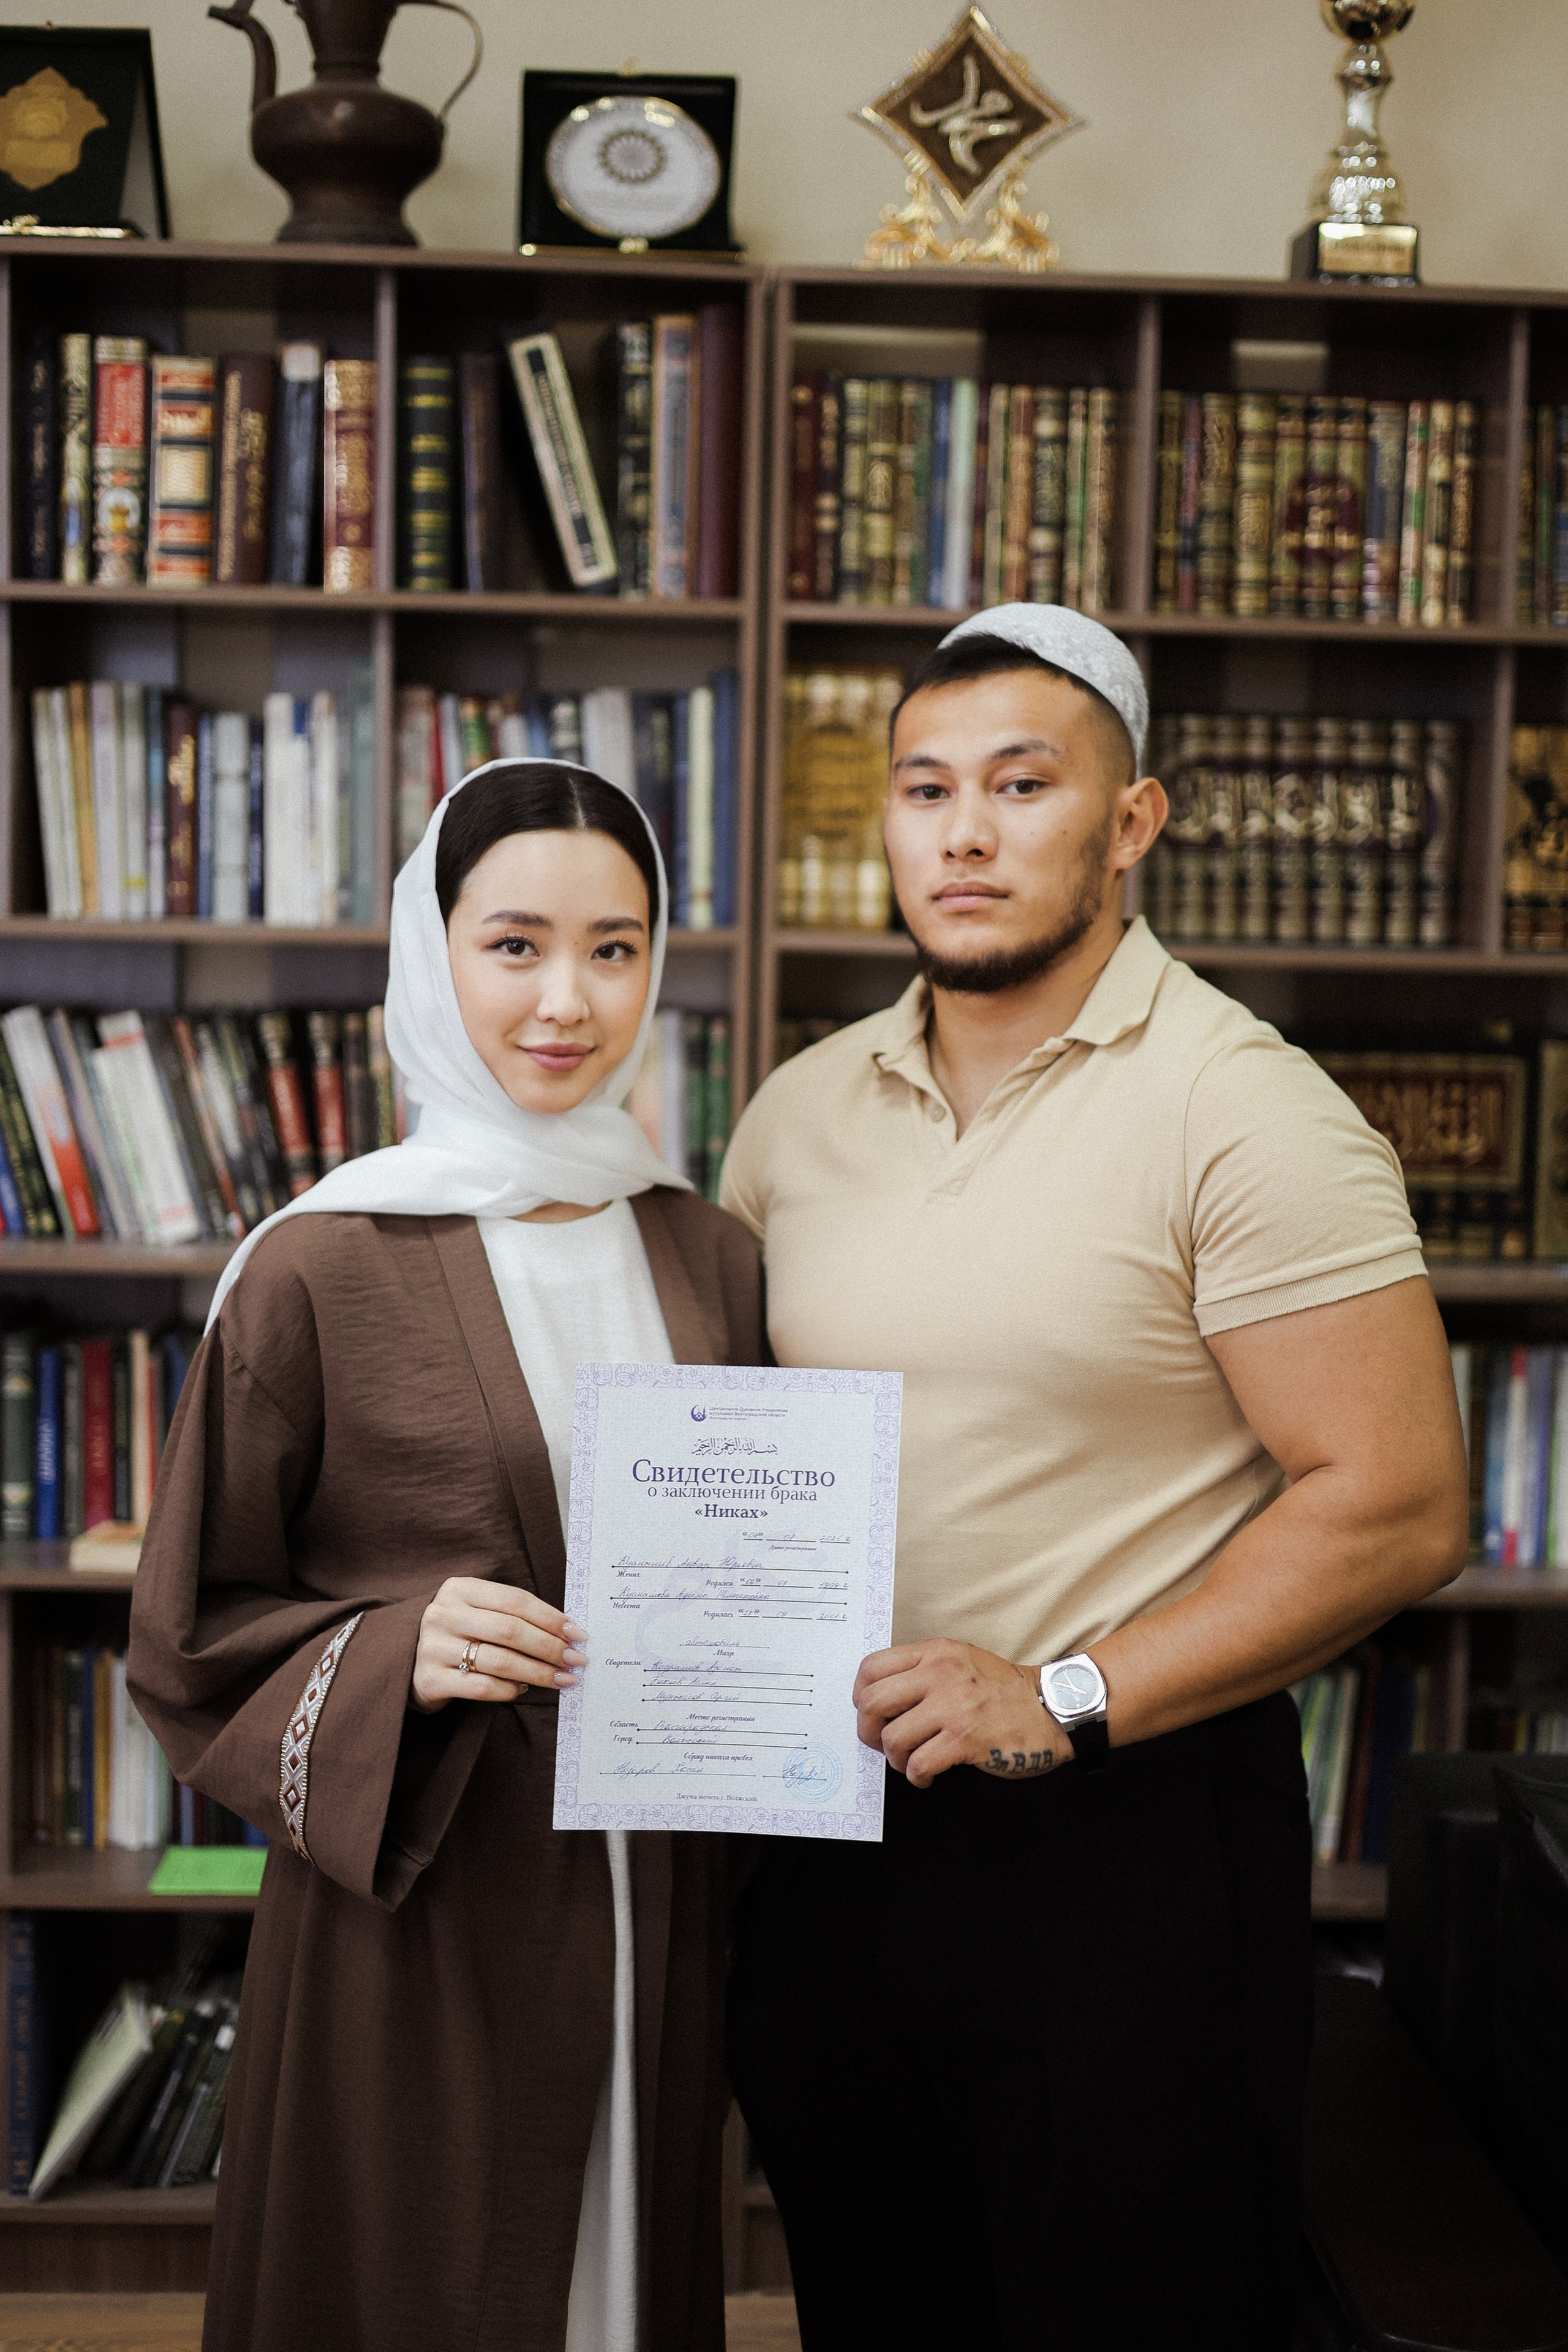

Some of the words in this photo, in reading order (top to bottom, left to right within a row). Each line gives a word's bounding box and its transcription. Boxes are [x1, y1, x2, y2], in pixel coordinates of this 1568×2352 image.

[631, 1459, 835, 1487] Свидетельство
[647, 1487, 657, 1498] о
[662, 1487, 766, 1500] заключении
[771, 1485, 818, 1504] брака
[695, 1504, 768, 1518] «Никах»
[719, 1555, 766, 1571] Юрьевич
[612, 1600, 641, 1609] Невеста
[685, 1636, 741, 1647] автомобиль
[713, 1649, 734, 1658] Махр
[710, 1715, 755, 1724] регистрации
[684, 1752, 705, 1762] Обряд
